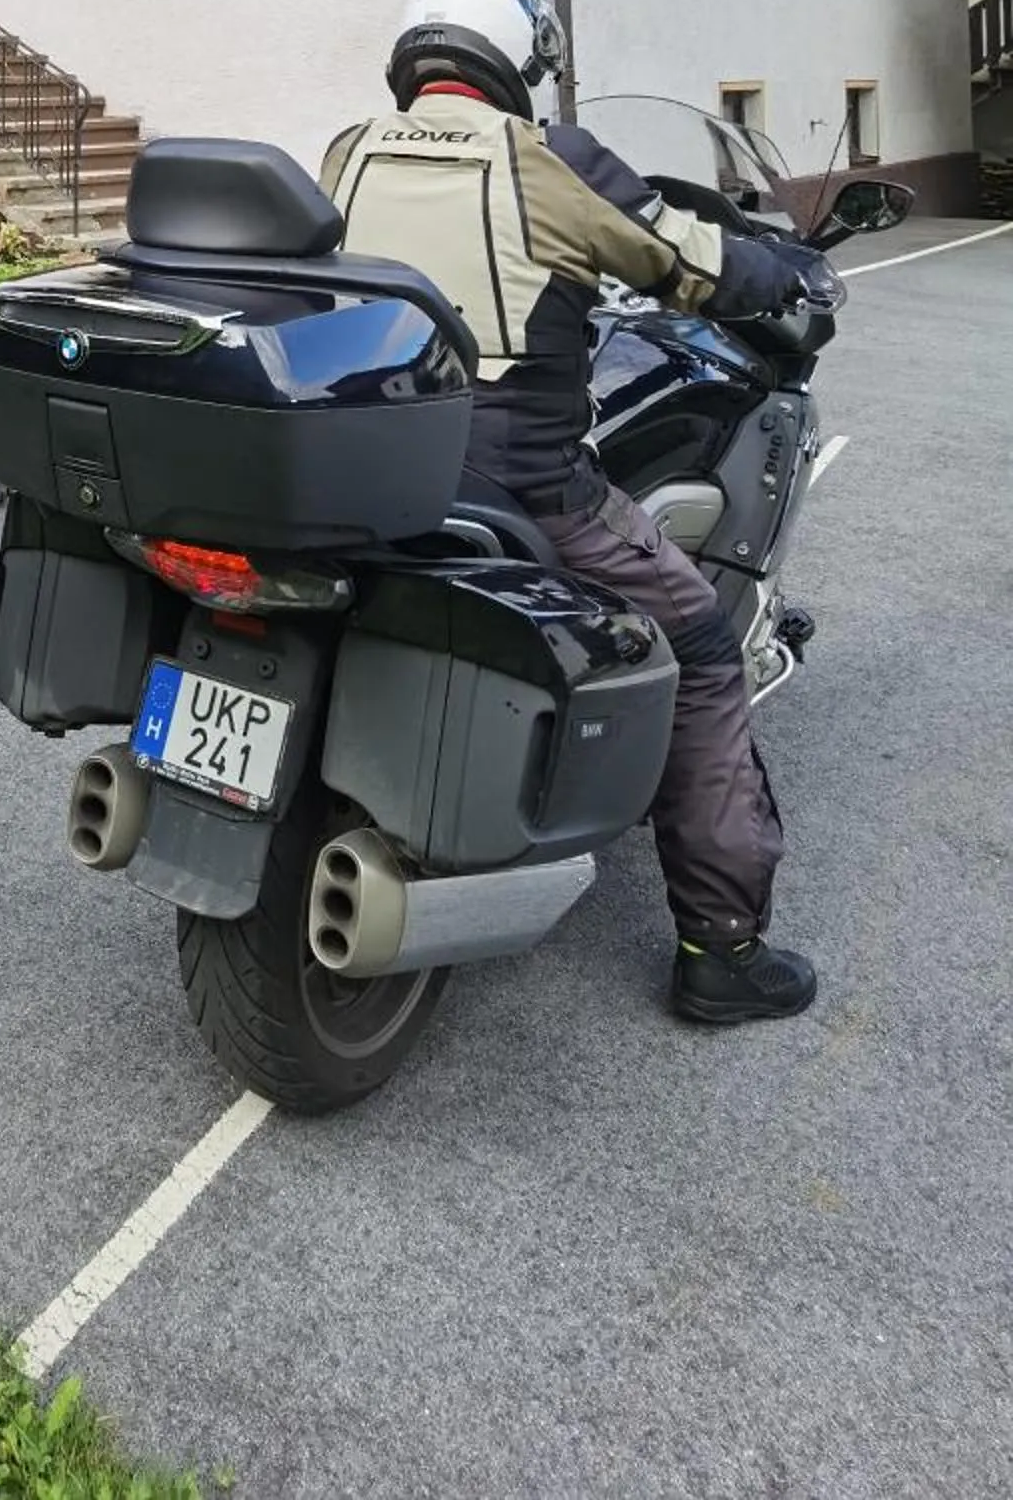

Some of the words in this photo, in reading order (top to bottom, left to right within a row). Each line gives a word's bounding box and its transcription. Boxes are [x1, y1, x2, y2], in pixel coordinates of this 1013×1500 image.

[145, 715, 162, 740] H
[190, 681, 271, 737] UKP
[581, 723, 603, 738] BMW
[184, 727, 252, 784] 241
